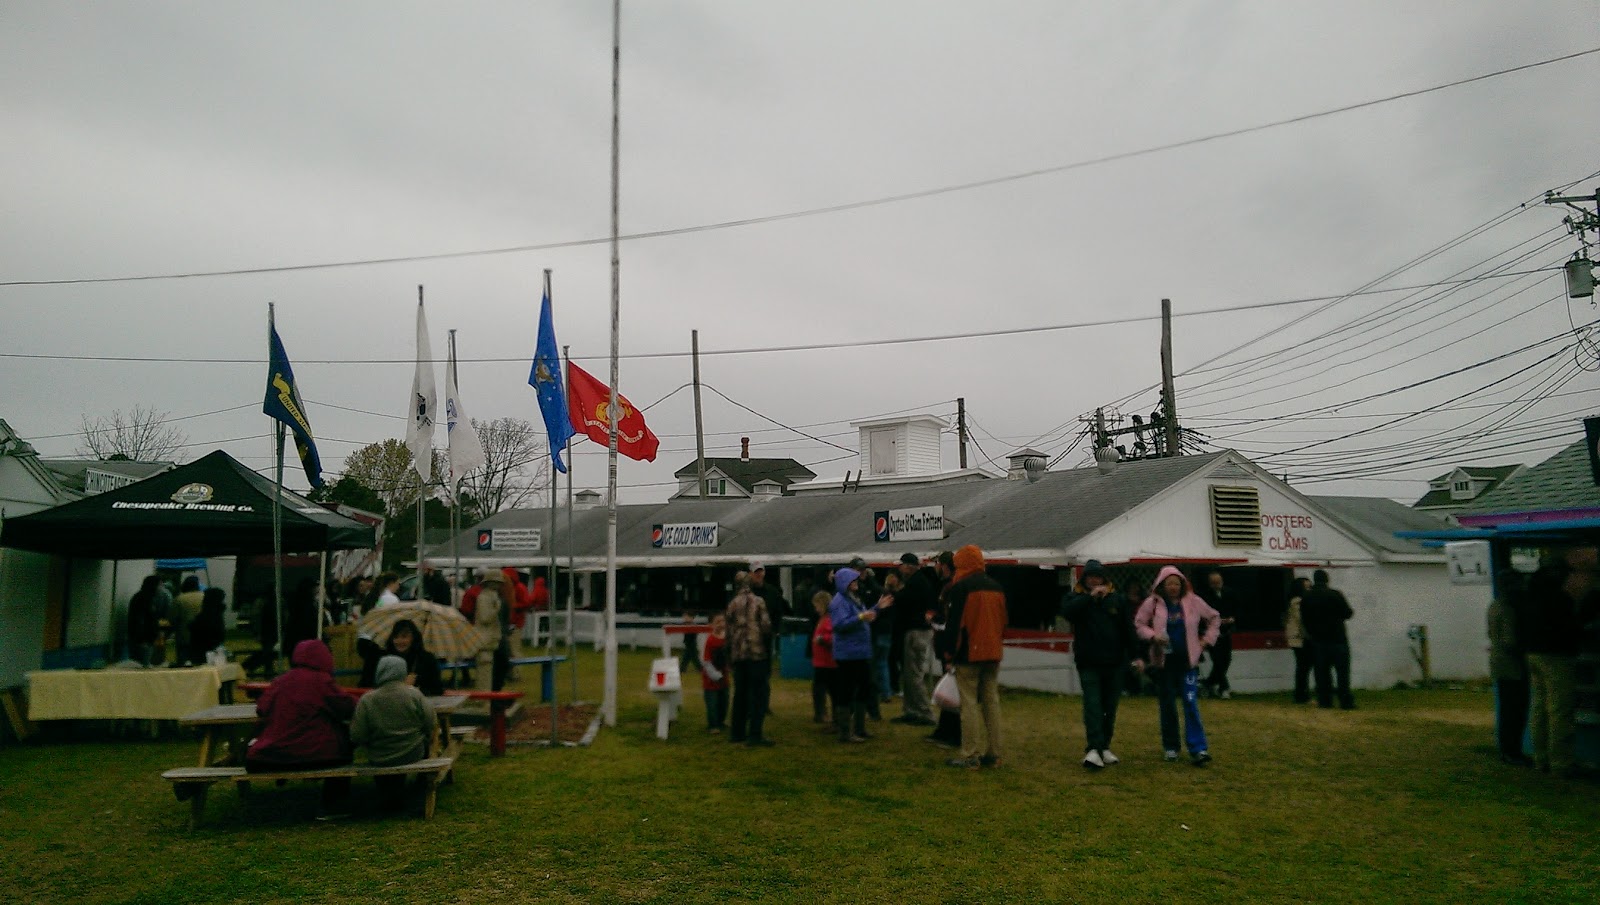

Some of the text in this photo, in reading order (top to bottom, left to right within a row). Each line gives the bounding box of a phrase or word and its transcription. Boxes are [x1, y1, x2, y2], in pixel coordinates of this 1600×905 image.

[112, 501, 184, 510] Chesapeake
[184, 503, 235, 512] Brewing
[890, 512, 943, 537] Oyster & Clam Fritters
[1261, 514, 1313, 528] OYSTERS
[663, 525, 716, 545] ICE COLD DRINKS
[1284, 526, 1292, 539] &
[1269, 537, 1309, 550] CLAMS
